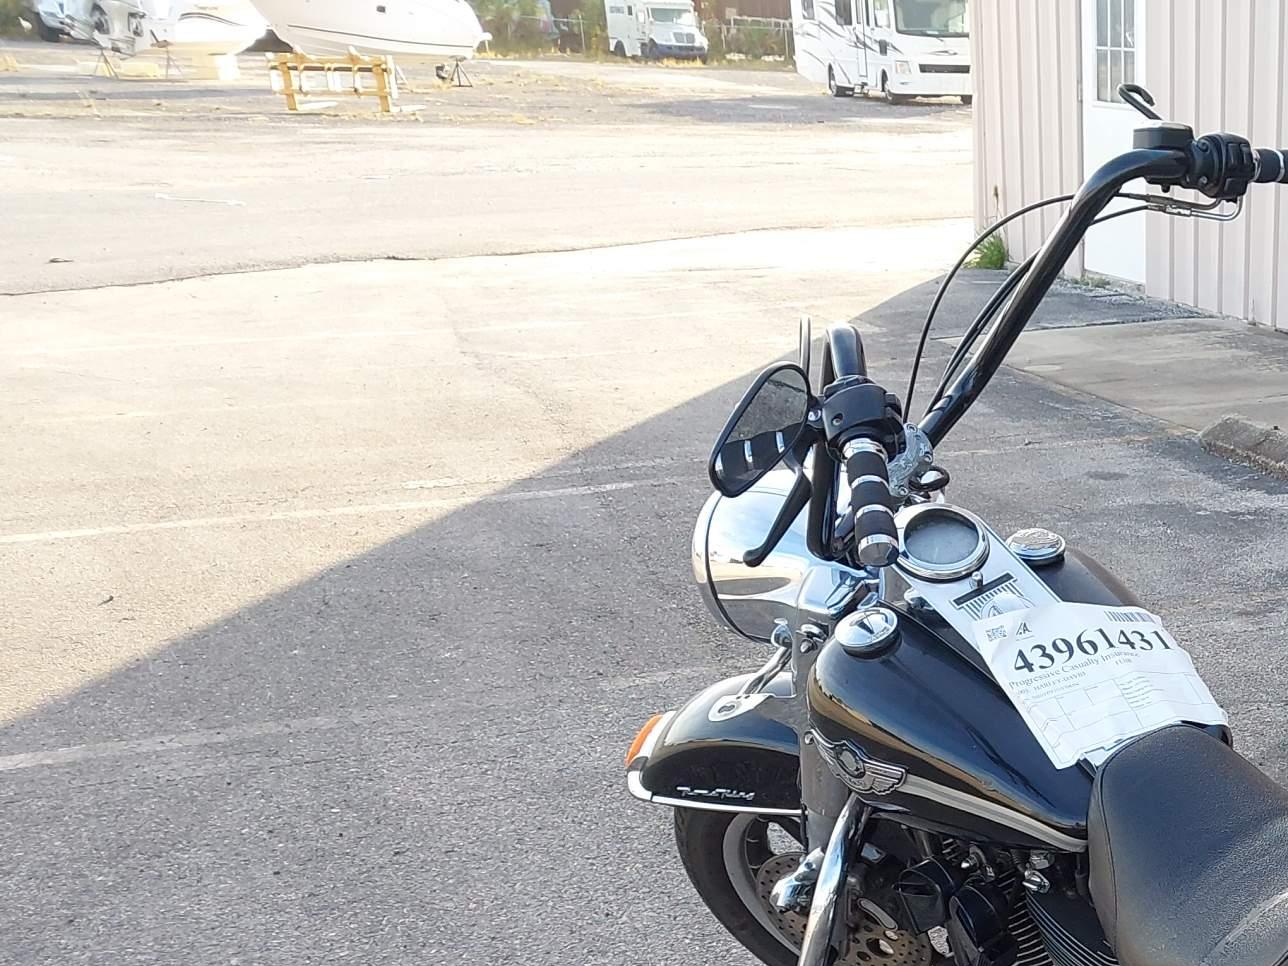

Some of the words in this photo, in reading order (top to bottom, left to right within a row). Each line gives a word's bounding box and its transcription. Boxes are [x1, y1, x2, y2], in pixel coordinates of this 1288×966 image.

[1014, 627, 1174, 673] 43961431
[1008, 667, 1061, 690] Progressive
[1061, 655, 1100, 673] Casualty
